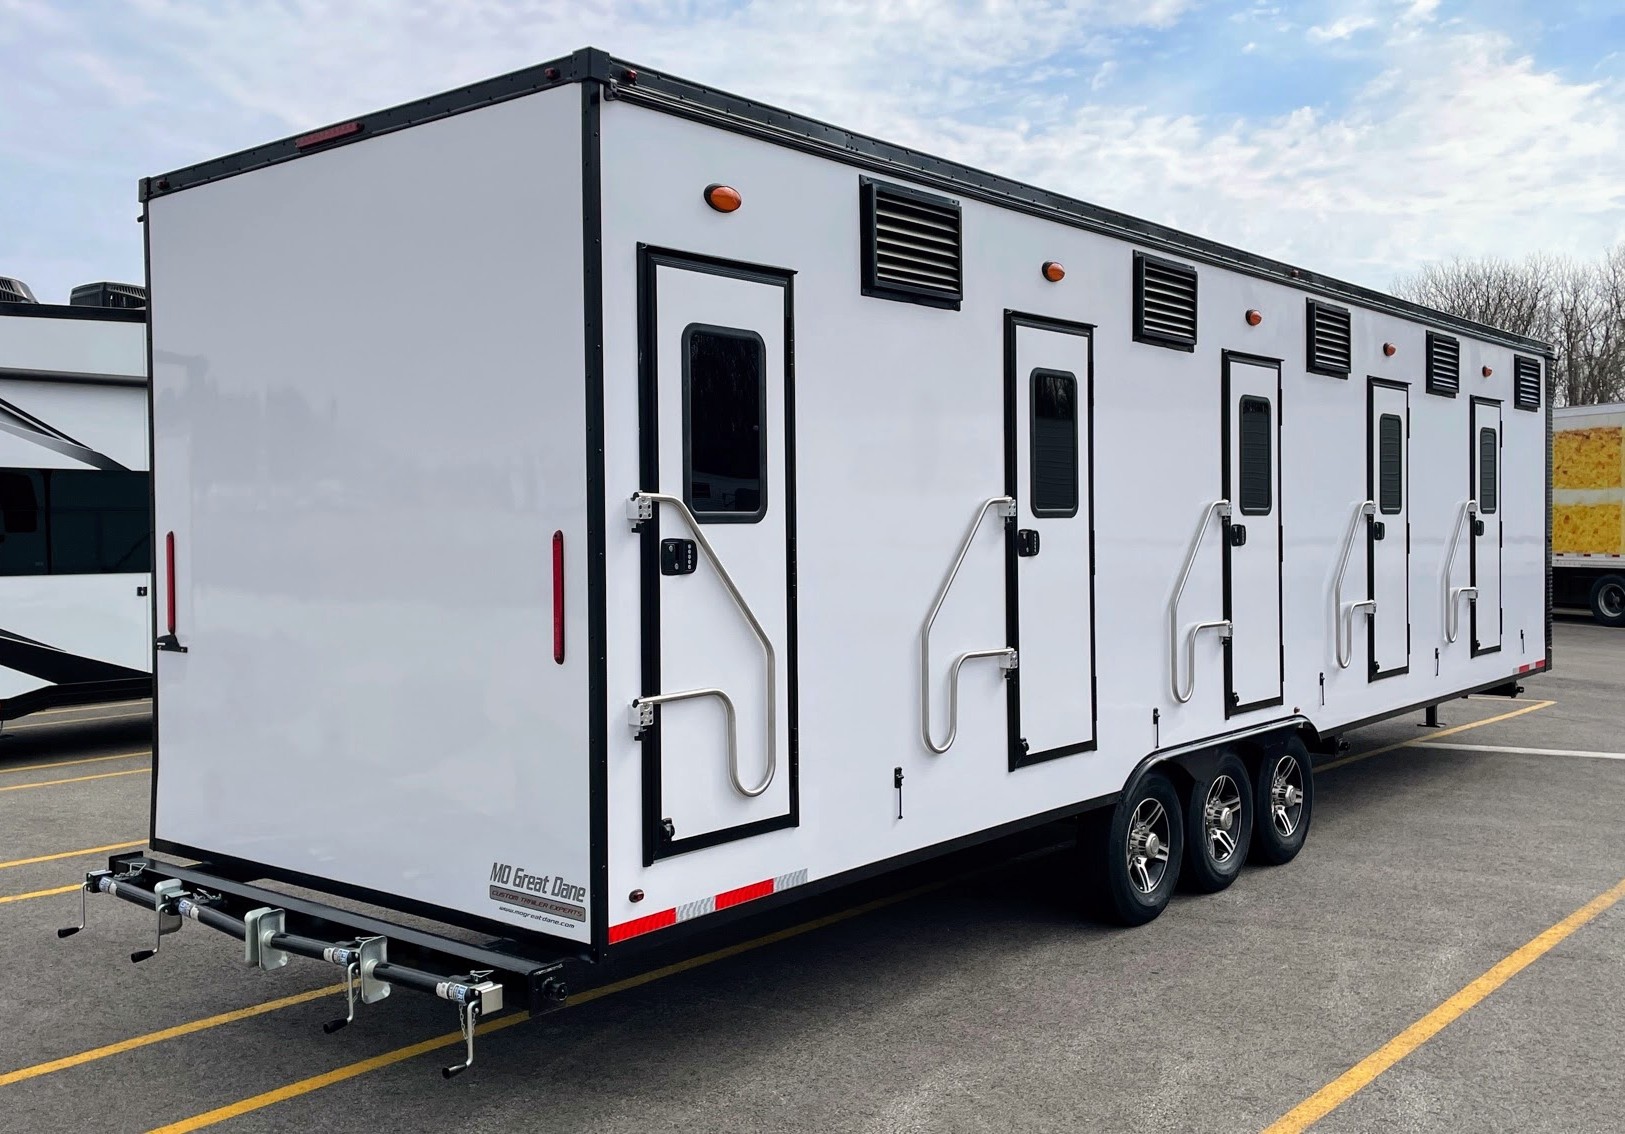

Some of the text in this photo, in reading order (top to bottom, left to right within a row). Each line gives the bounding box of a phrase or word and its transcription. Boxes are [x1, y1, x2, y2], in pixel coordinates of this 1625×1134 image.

[490, 862, 586, 903] MO Great Dane
[492, 890, 583, 917] CUSTOM TRAILER EXPERTS
